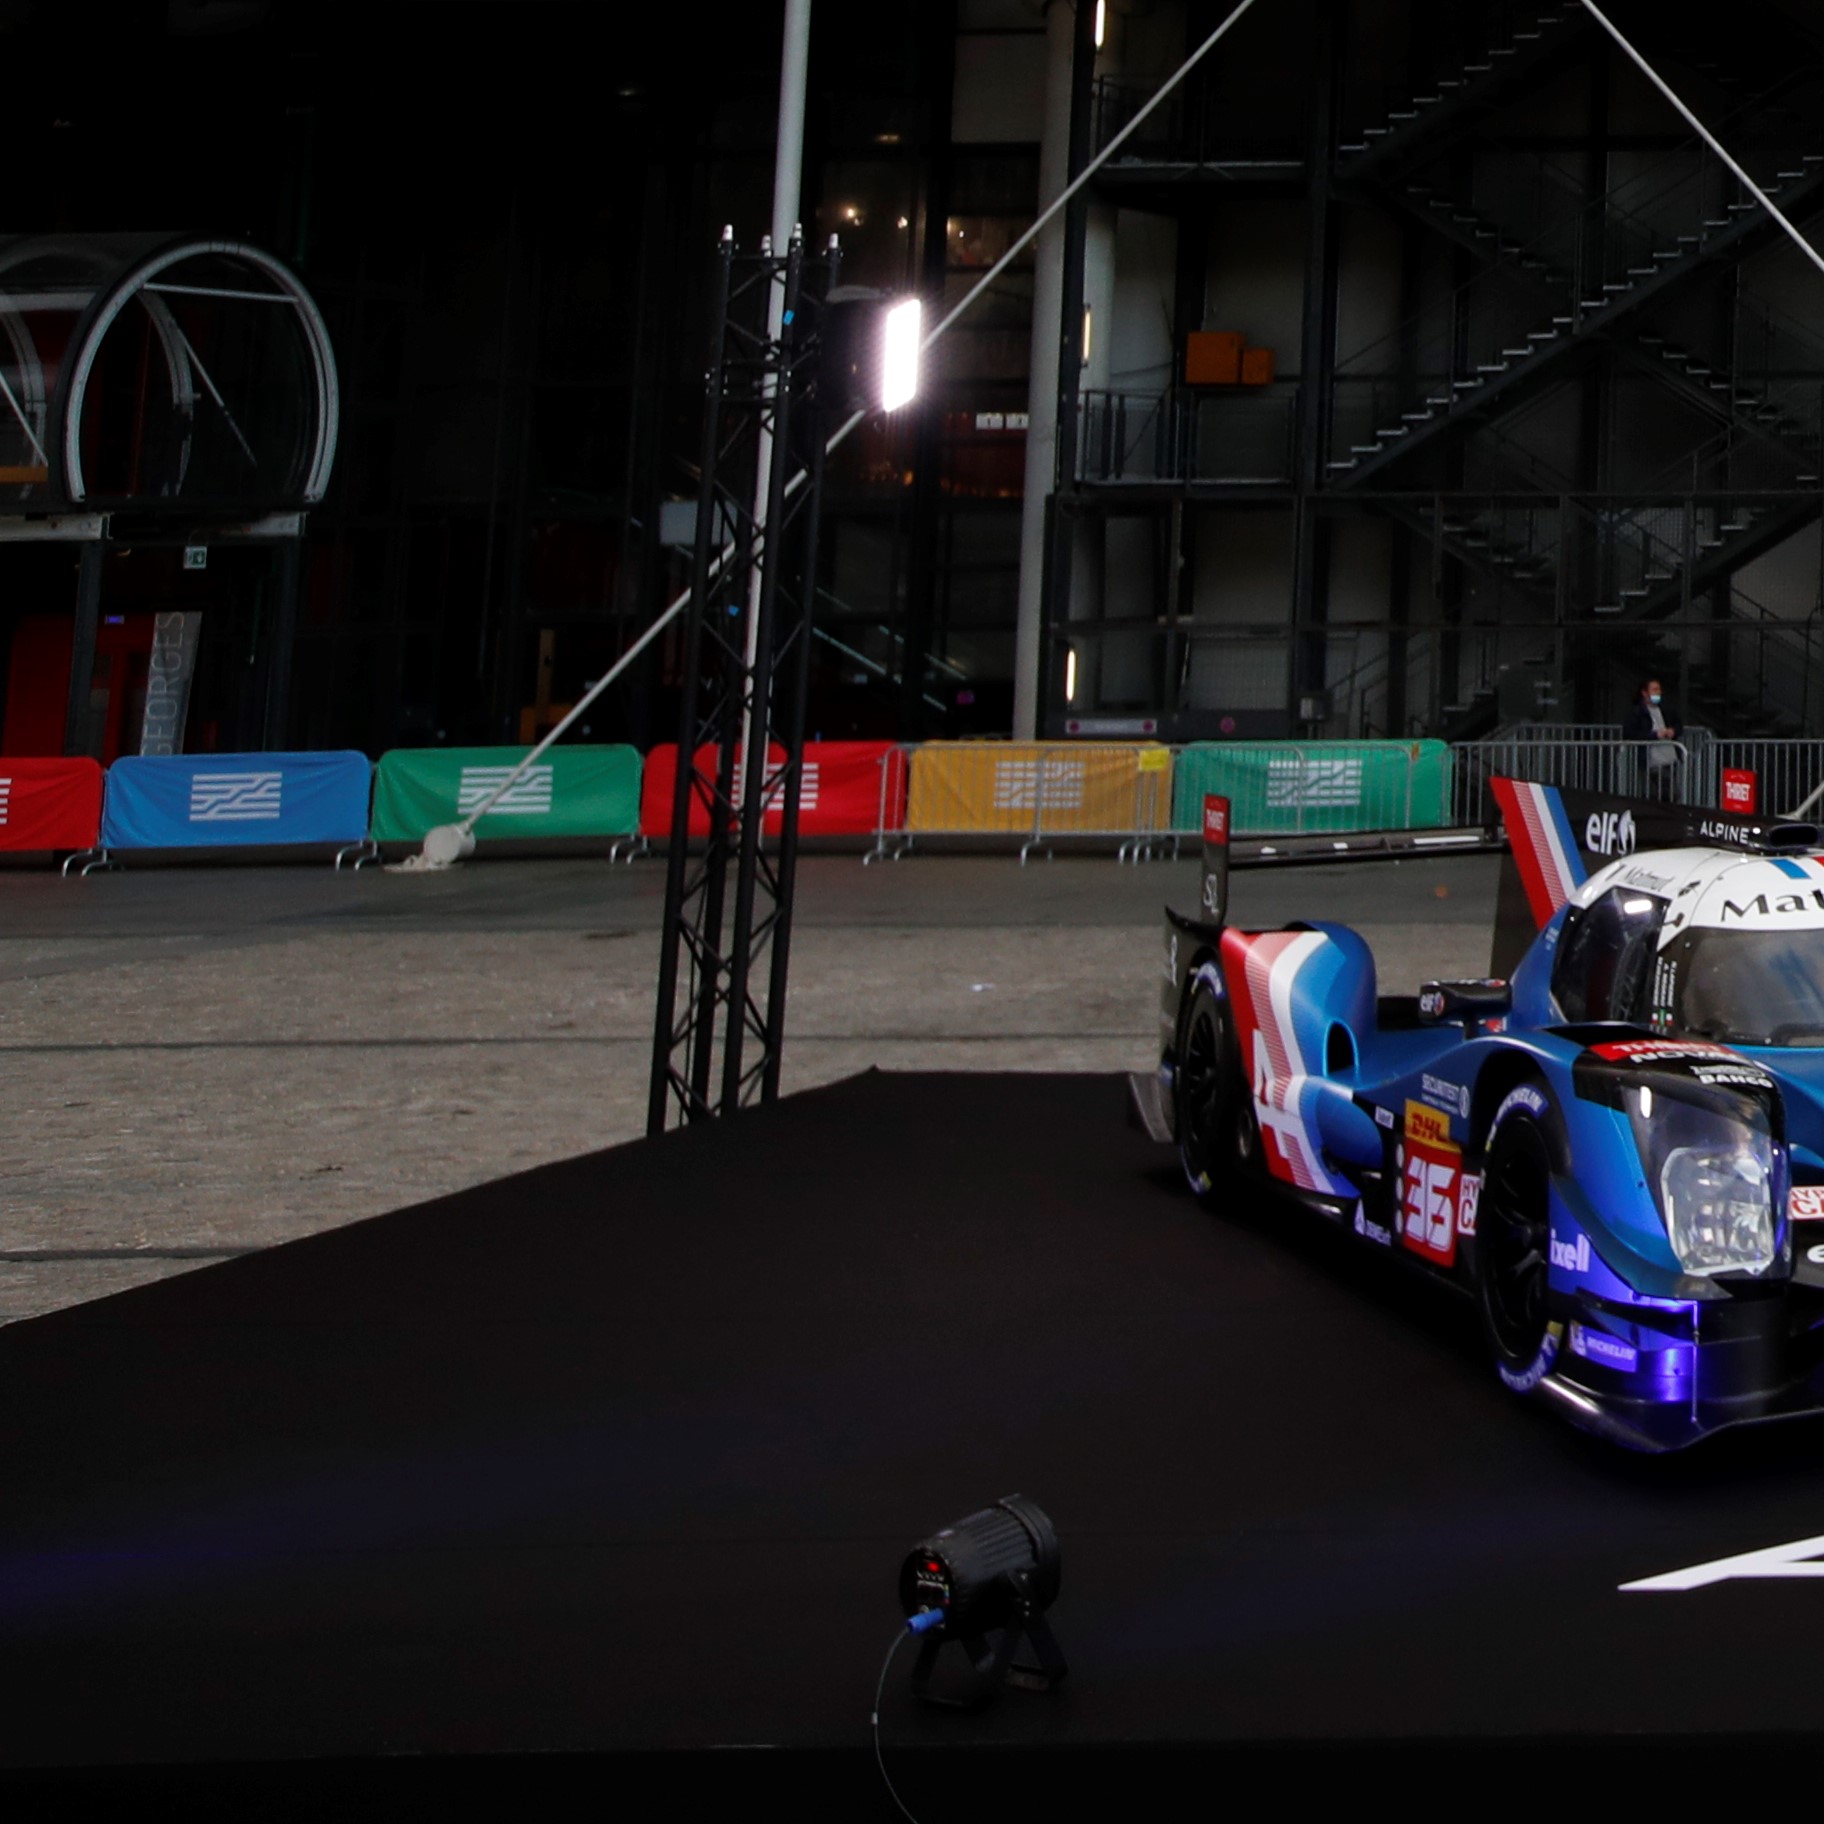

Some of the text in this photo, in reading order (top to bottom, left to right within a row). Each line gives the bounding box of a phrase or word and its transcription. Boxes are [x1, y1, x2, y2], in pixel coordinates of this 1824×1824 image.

[141, 612, 184, 757] GEORGES
[1586, 812, 1618, 855] elf
[1700, 821, 1750, 845] ALPINE
[1700, 1074, 1774, 1089] BAHCO
[1411, 1110, 1449, 1143] DHL
[1406, 1155, 1456, 1253] 36
[1551, 1229, 1590, 1273] ixell
